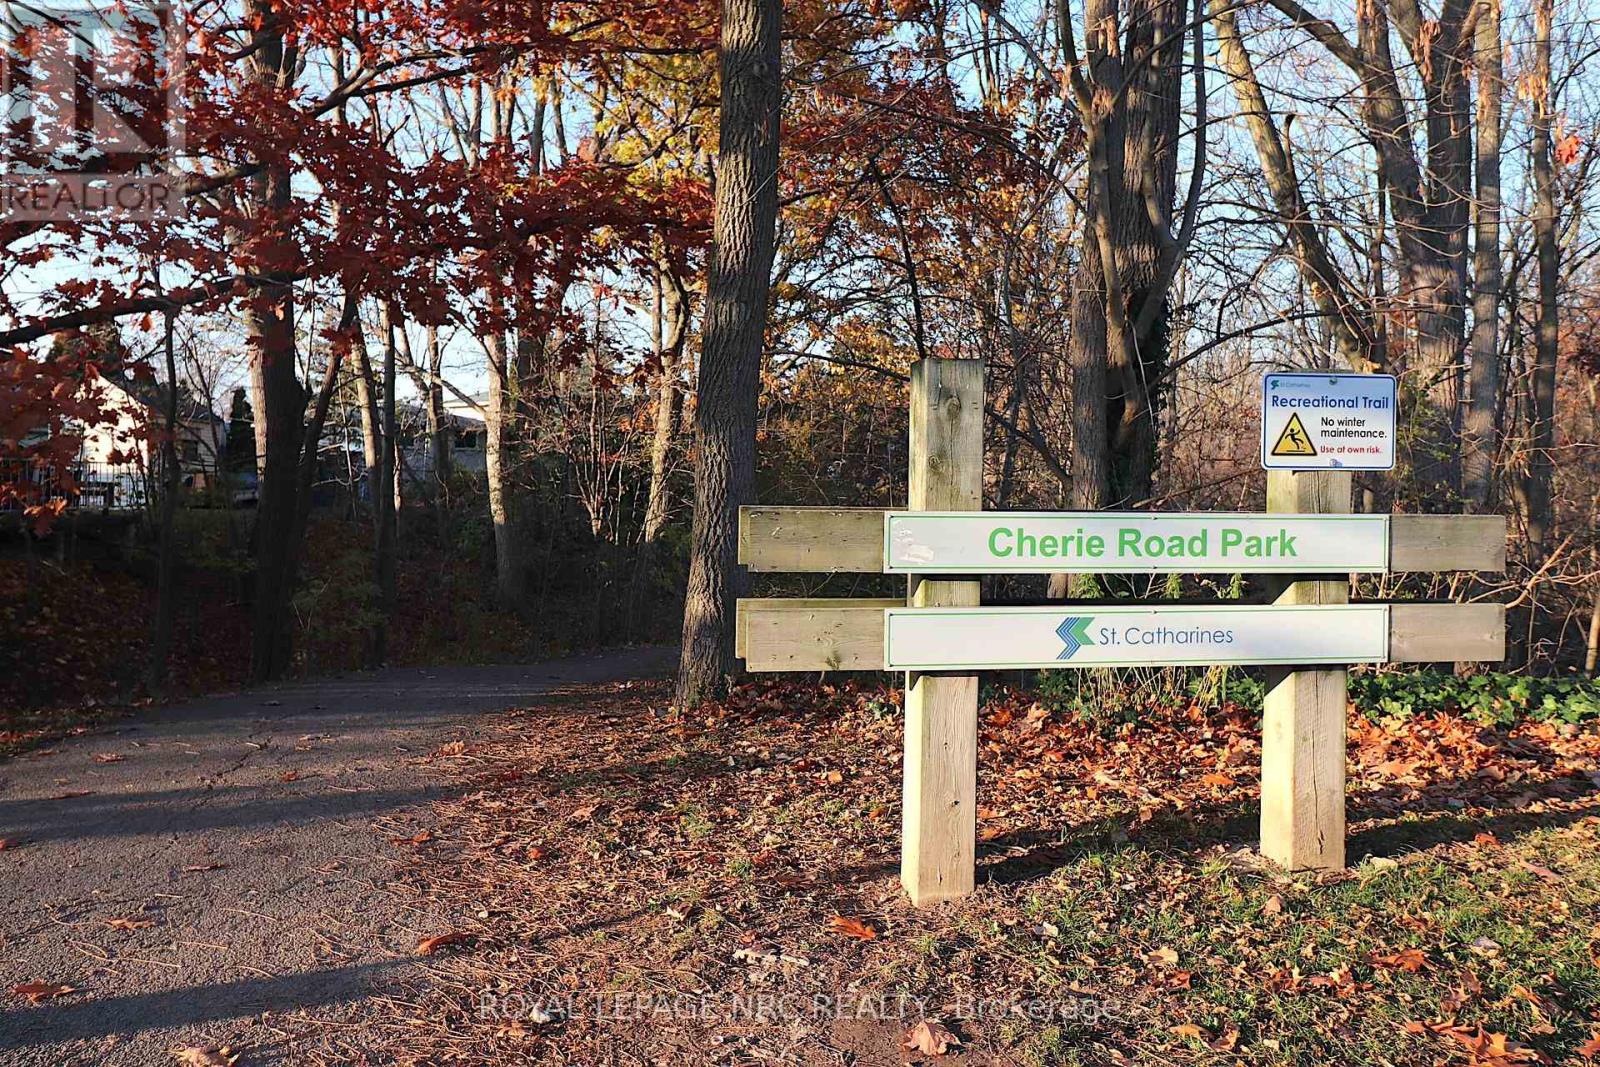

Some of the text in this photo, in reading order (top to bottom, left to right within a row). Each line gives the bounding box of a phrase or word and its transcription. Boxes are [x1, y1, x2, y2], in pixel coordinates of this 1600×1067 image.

[1271, 395, 1389, 409] Recreational Trail
[1321, 416, 1366, 427] No winter
[1320, 428, 1388, 439] maintenance.
[1320, 446, 1335, 454] Use
[1337, 446, 1347, 454] at
[1366, 446, 1383, 454] risk.
[988, 528, 1297, 557] Cherie Road Park
[1100, 626, 1234, 646] St. Catharines
